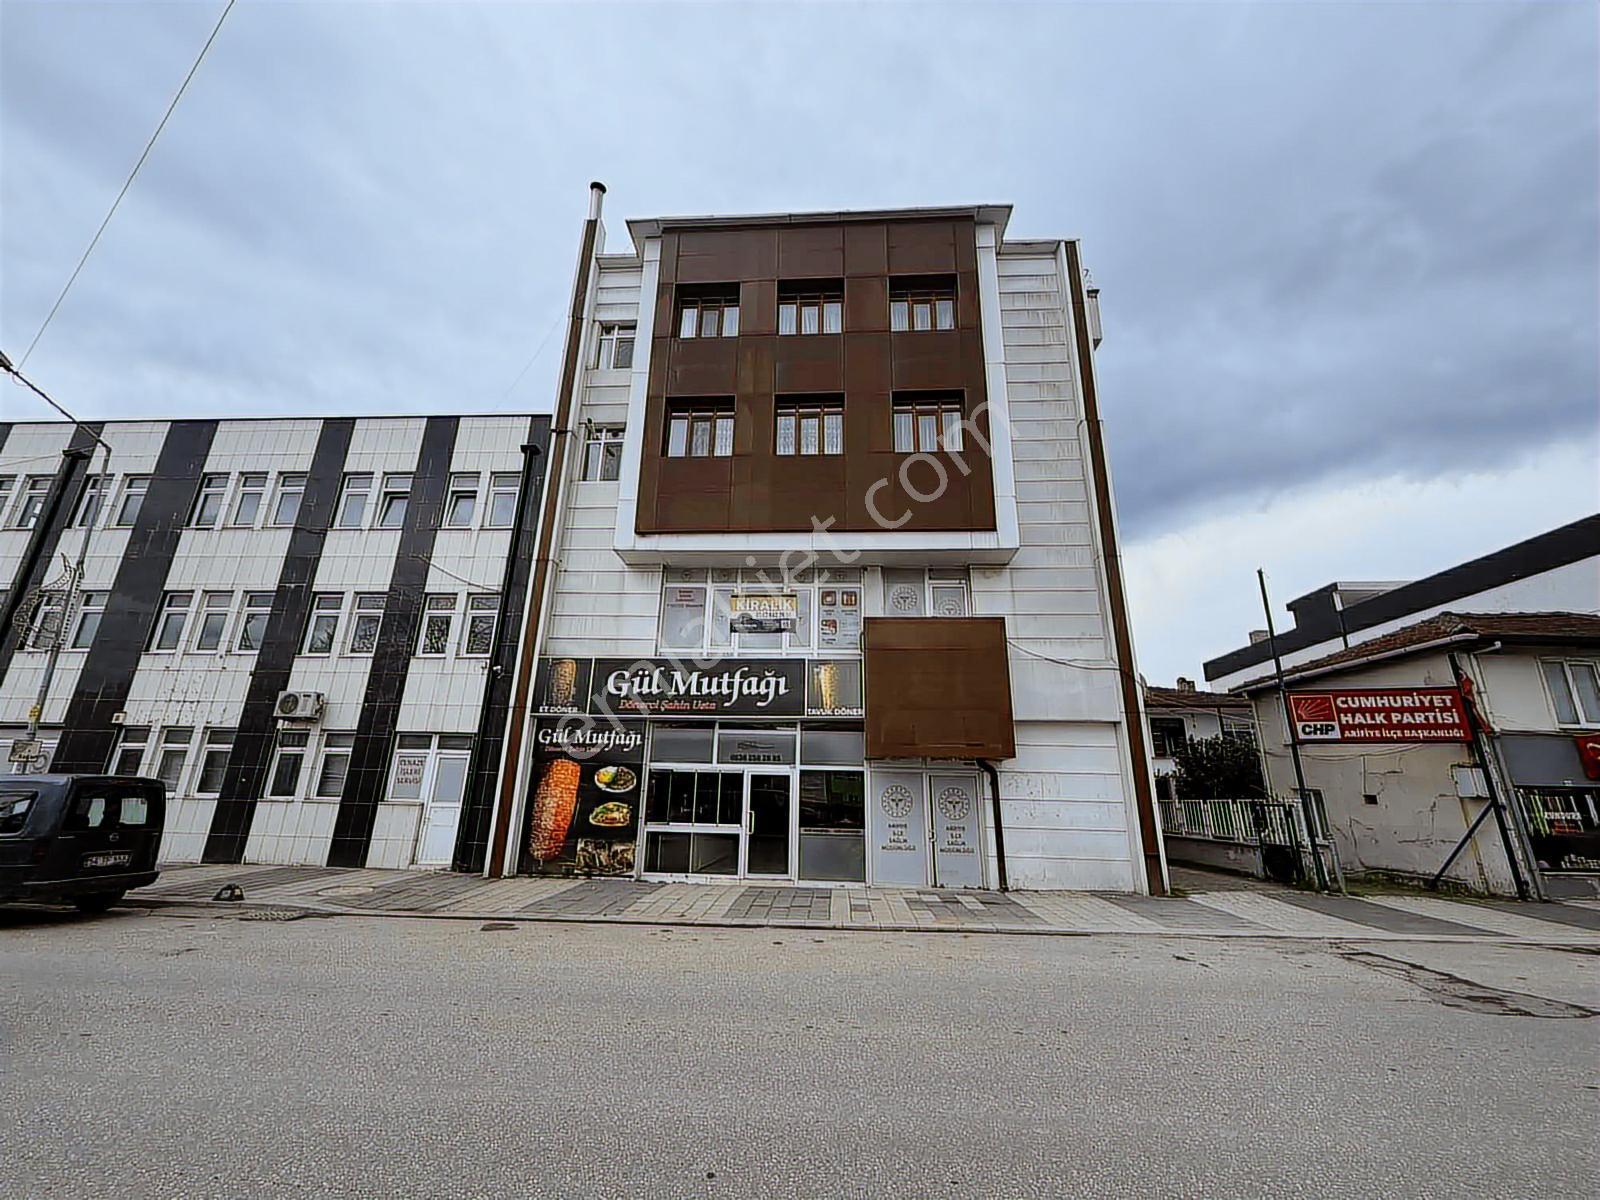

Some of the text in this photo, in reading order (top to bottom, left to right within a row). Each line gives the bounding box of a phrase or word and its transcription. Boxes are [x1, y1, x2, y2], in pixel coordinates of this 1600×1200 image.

[607, 667, 790, 708] Gül Mutfağı
[1336, 692, 1453, 708] CUMHURİYET
[1340, 709, 1460, 724] HALK PARTİSİ
[1301, 724, 1336, 735] CHP
[538, 726, 643, 752] Gül Mutfağı
